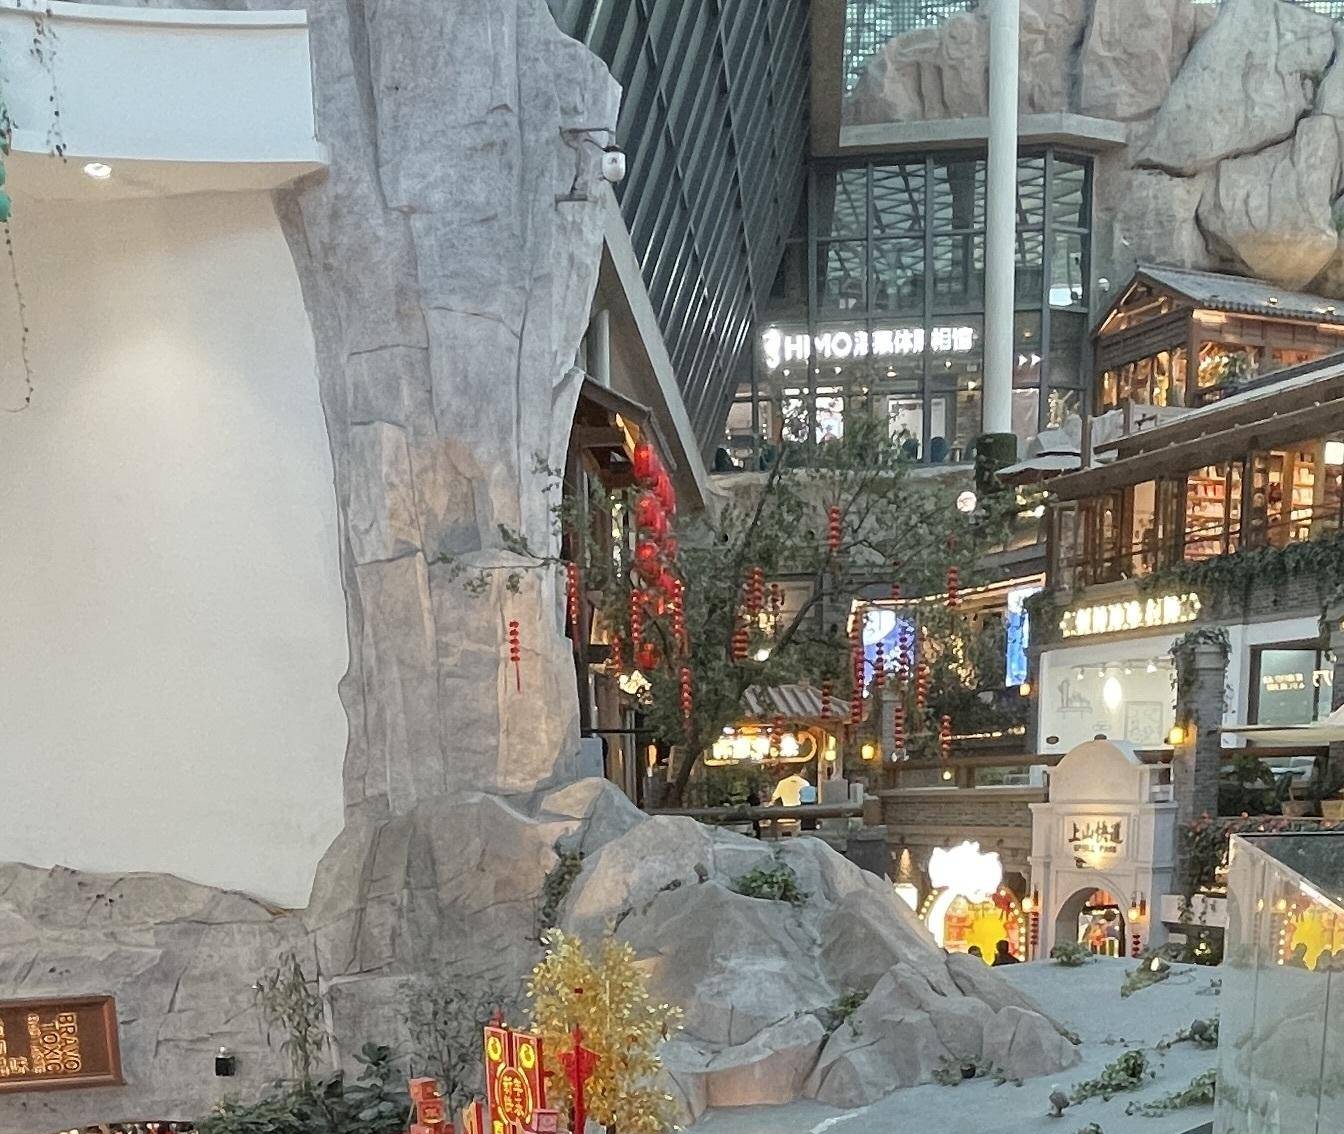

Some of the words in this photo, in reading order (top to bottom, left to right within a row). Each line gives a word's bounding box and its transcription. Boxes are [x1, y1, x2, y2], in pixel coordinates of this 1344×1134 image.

[784, 332, 852, 360] HIMO
[40, 1020, 62, 1073] TOXIC
[58, 1012, 81, 1073] BRAVO
